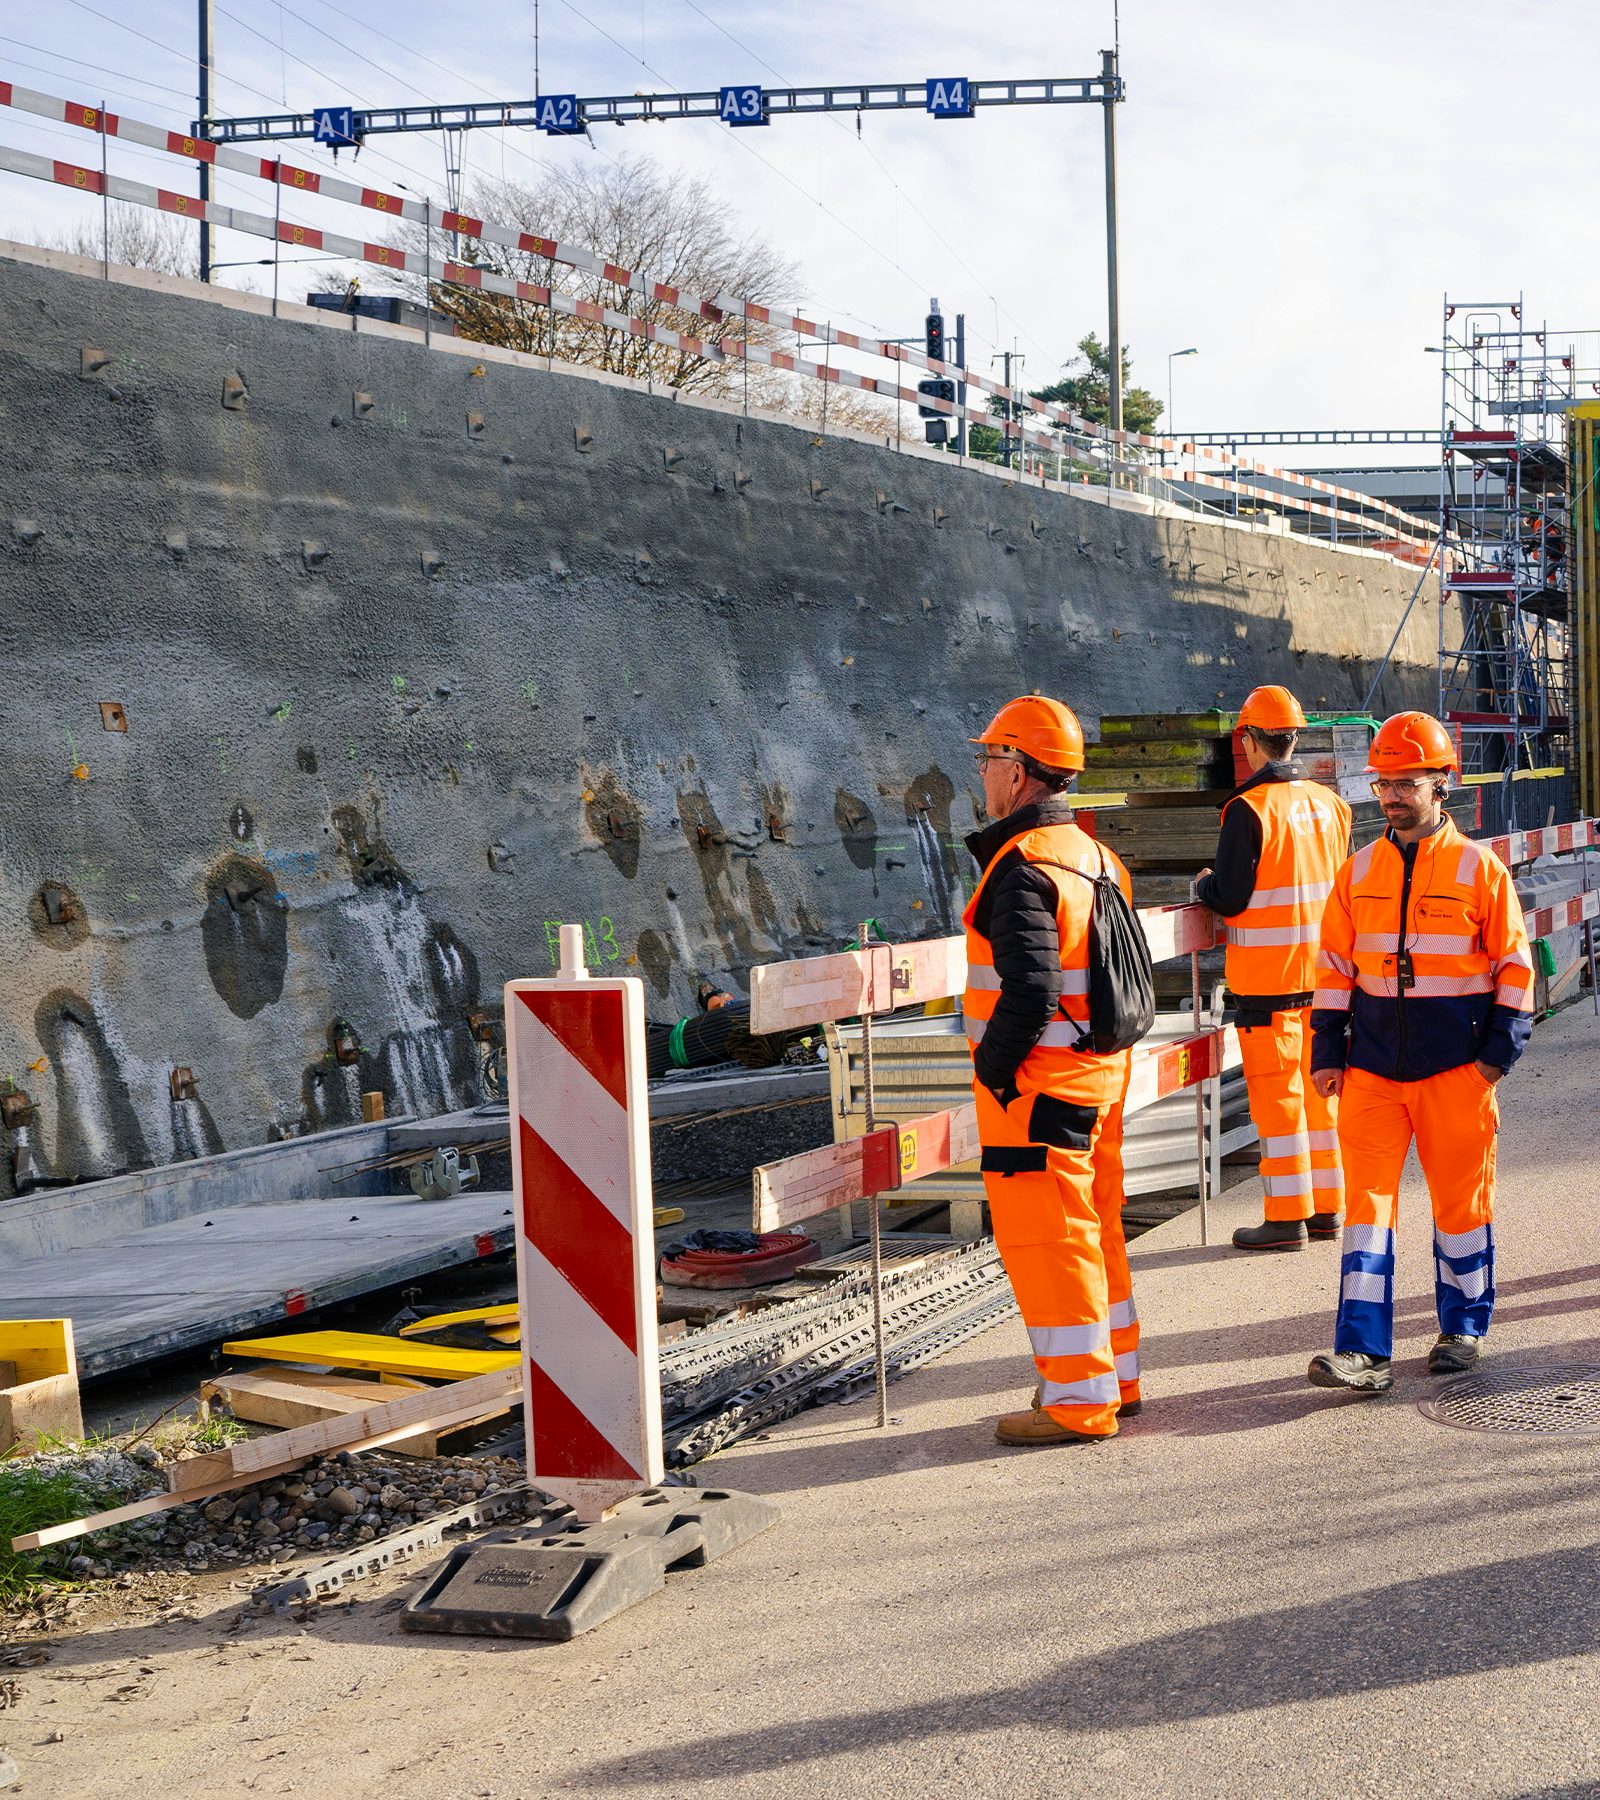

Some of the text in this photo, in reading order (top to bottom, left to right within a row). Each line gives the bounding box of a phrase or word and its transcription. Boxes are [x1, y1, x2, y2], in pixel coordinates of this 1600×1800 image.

[722, 89, 759, 118] A3
[931, 81, 964, 109] A4
[317, 110, 350, 139] A1
[540, 98, 573, 126] A2
